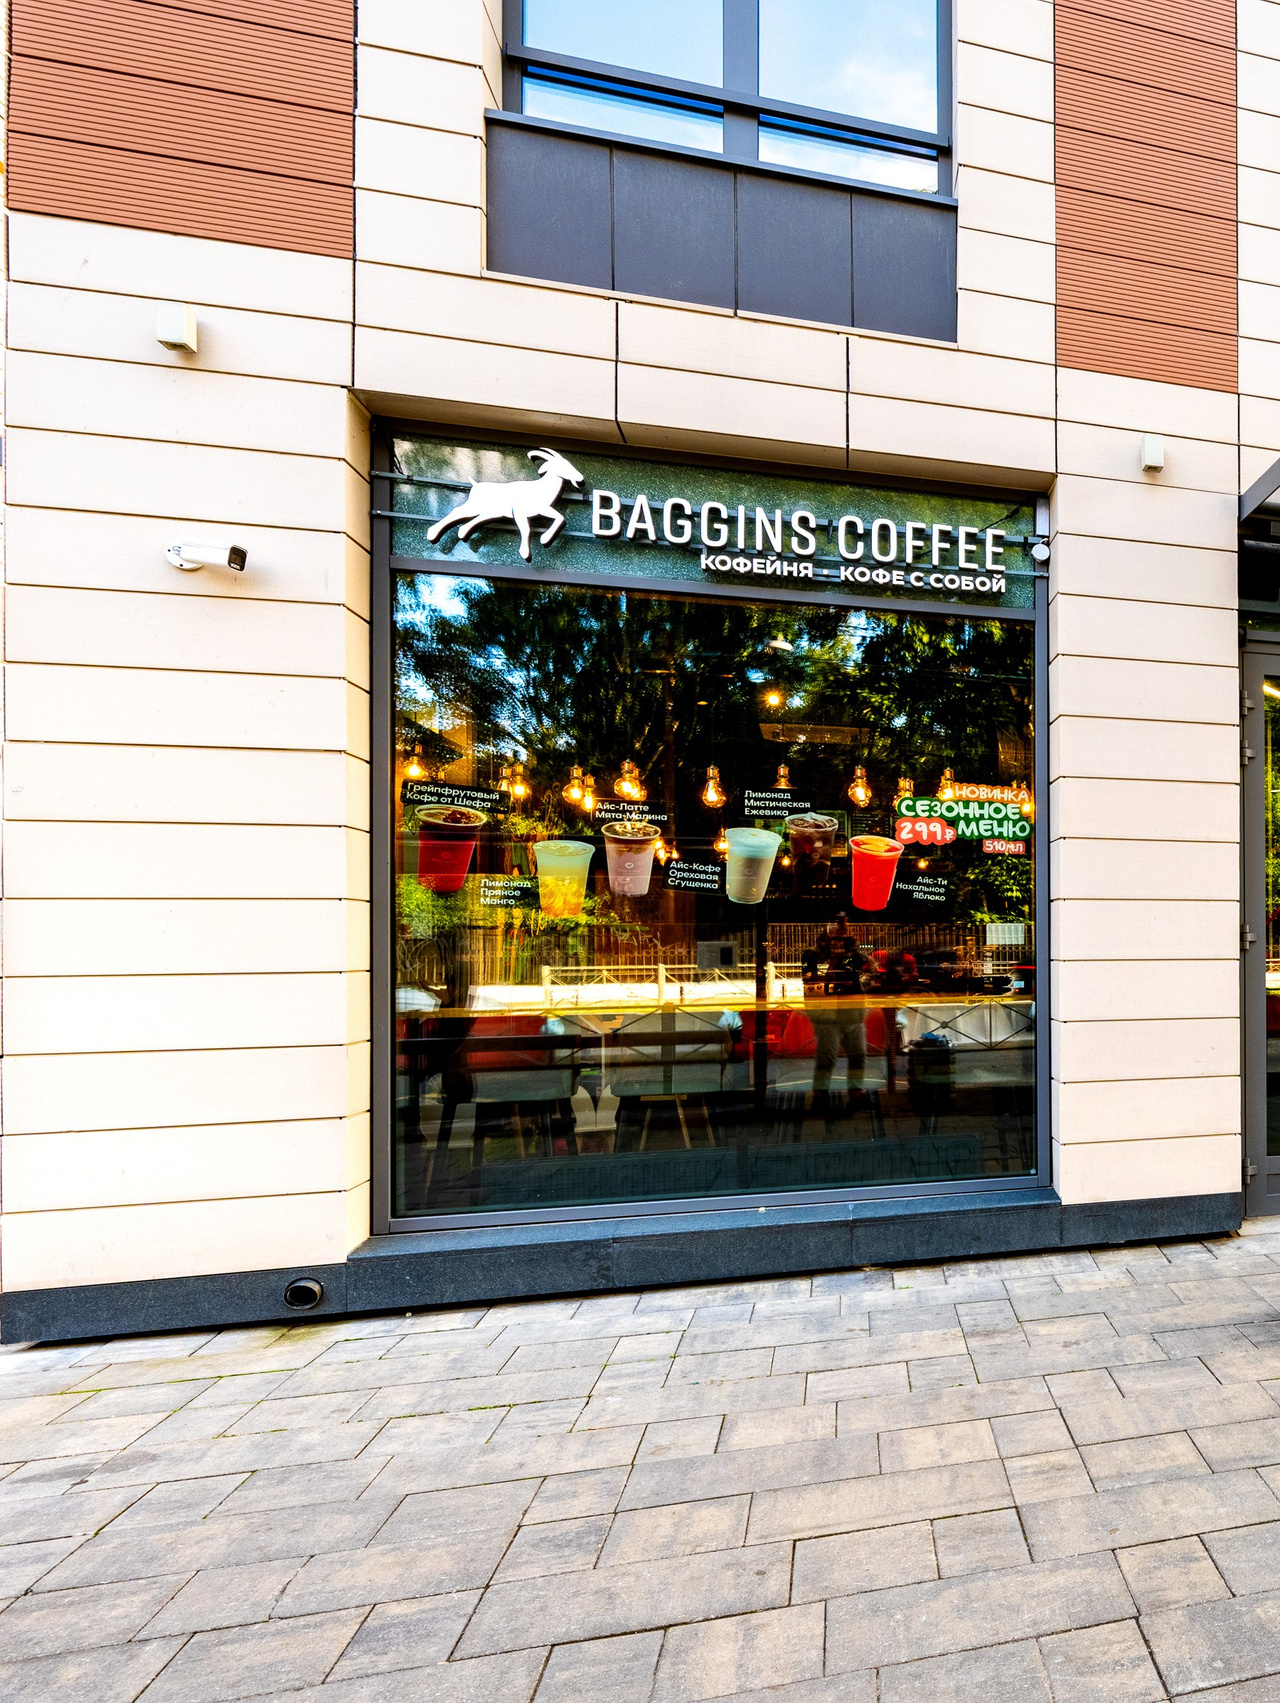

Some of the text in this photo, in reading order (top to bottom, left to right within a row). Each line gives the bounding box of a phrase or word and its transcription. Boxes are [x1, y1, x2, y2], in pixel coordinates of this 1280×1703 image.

[591, 489, 1006, 571] BAGGINS COFFEE
[700, 555, 1006, 594] КОФЕЙНЯ КОФЕ С СОБОЙ
[407, 783, 500, 800] Грейпфрутовый
[744, 790, 792, 799] Лимонад
[955, 785, 1030, 802] НОВИНКА
[406, 791, 491, 808] Кофе от Шефа
[744, 799, 810, 808] Мистическая
[596, 802, 650, 812] Айс-Латте
[744, 808, 789, 816] Ежевика
[900, 800, 1021, 820] СЕЗОННОЕ
[595, 811, 668, 821] Мята-Малина
[958, 820, 1031, 838] МЕНЮ
[670, 861, 721, 873] Айс-Кофе
[669, 870, 718, 881] Ореховая
[917, 876, 948, 885] Айс-Ти
[480, 879, 532, 888] Лимонад
[668, 878, 718, 889] Сгущенка
[896, 882, 946, 893] Нахальное
[480, 888, 521, 897] Пряное
[912, 892, 946, 901] Яблоко
[480, 896, 516, 906] Манго
